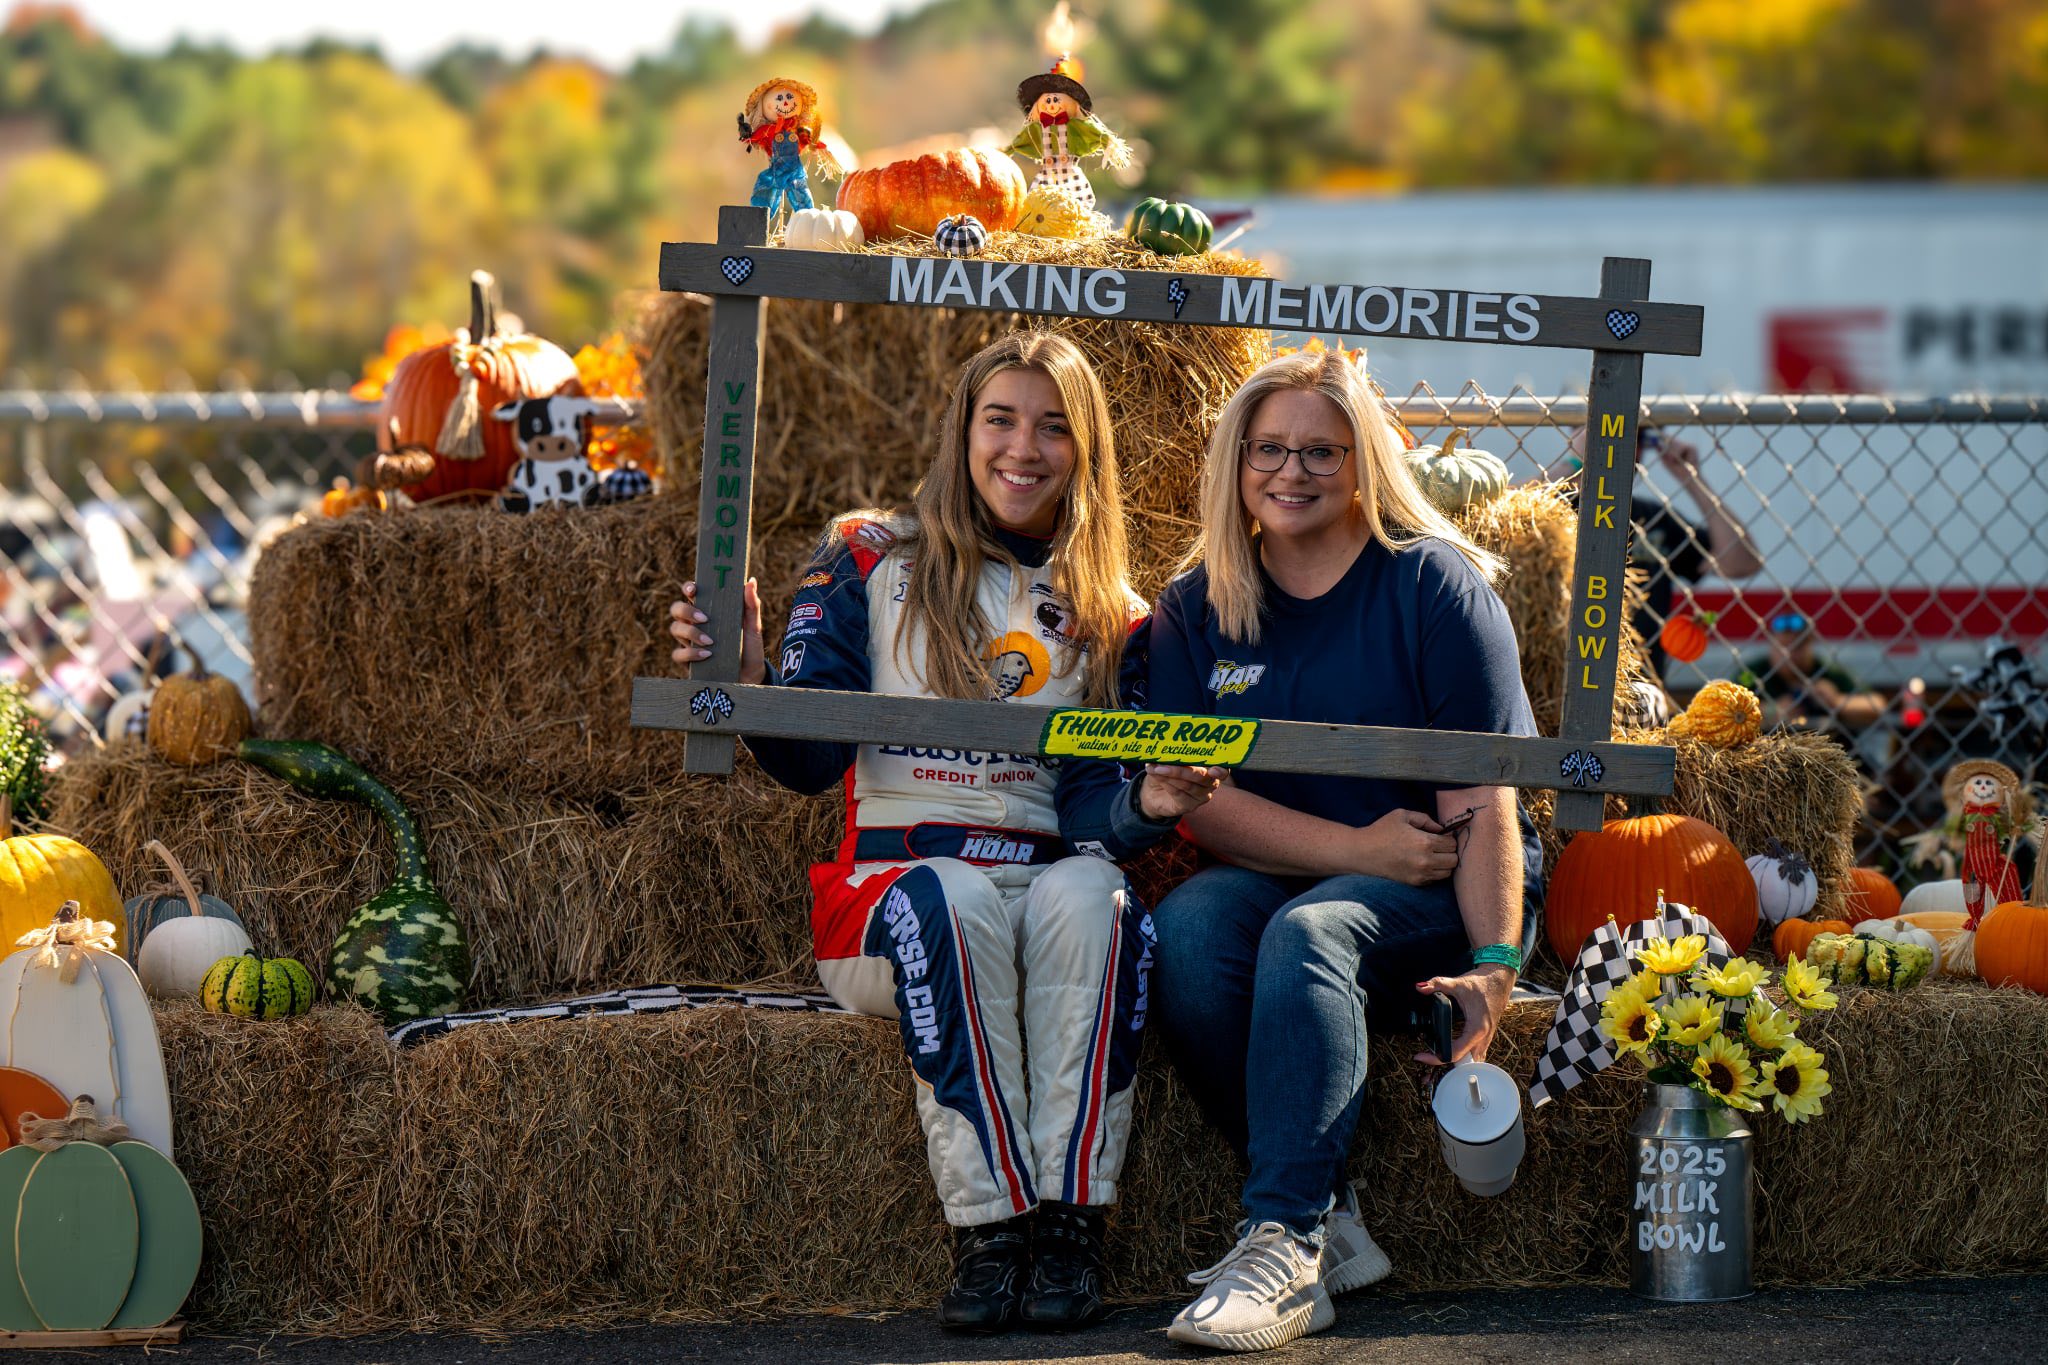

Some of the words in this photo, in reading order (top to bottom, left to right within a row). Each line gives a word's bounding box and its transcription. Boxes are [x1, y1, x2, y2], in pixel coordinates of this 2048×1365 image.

[889, 257, 1127, 316] MAKING
[1219, 276, 1541, 342] MEMORIES
[713, 380, 745, 589] VERMONT
[1594, 413, 1625, 529] MILK
[1578, 575, 1607, 689] BOWL
[1056, 715, 1171, 741] THUNDER
[1172, 721, 1243, 745] ROAD
[1122, 740, 1142, 753] site
[1146, 741, 1158, 755] of
[912, 767, 978, 785] CREDIT
[990, 770, 1036, 784] UNION
[960, 837, 1035, 864] HOAR
[1640, 1146, 1727, 1177] 2025
[1633, 1180, 1720, 1215] MILK
[1638, 1221, 1726, 1253] BOWL
